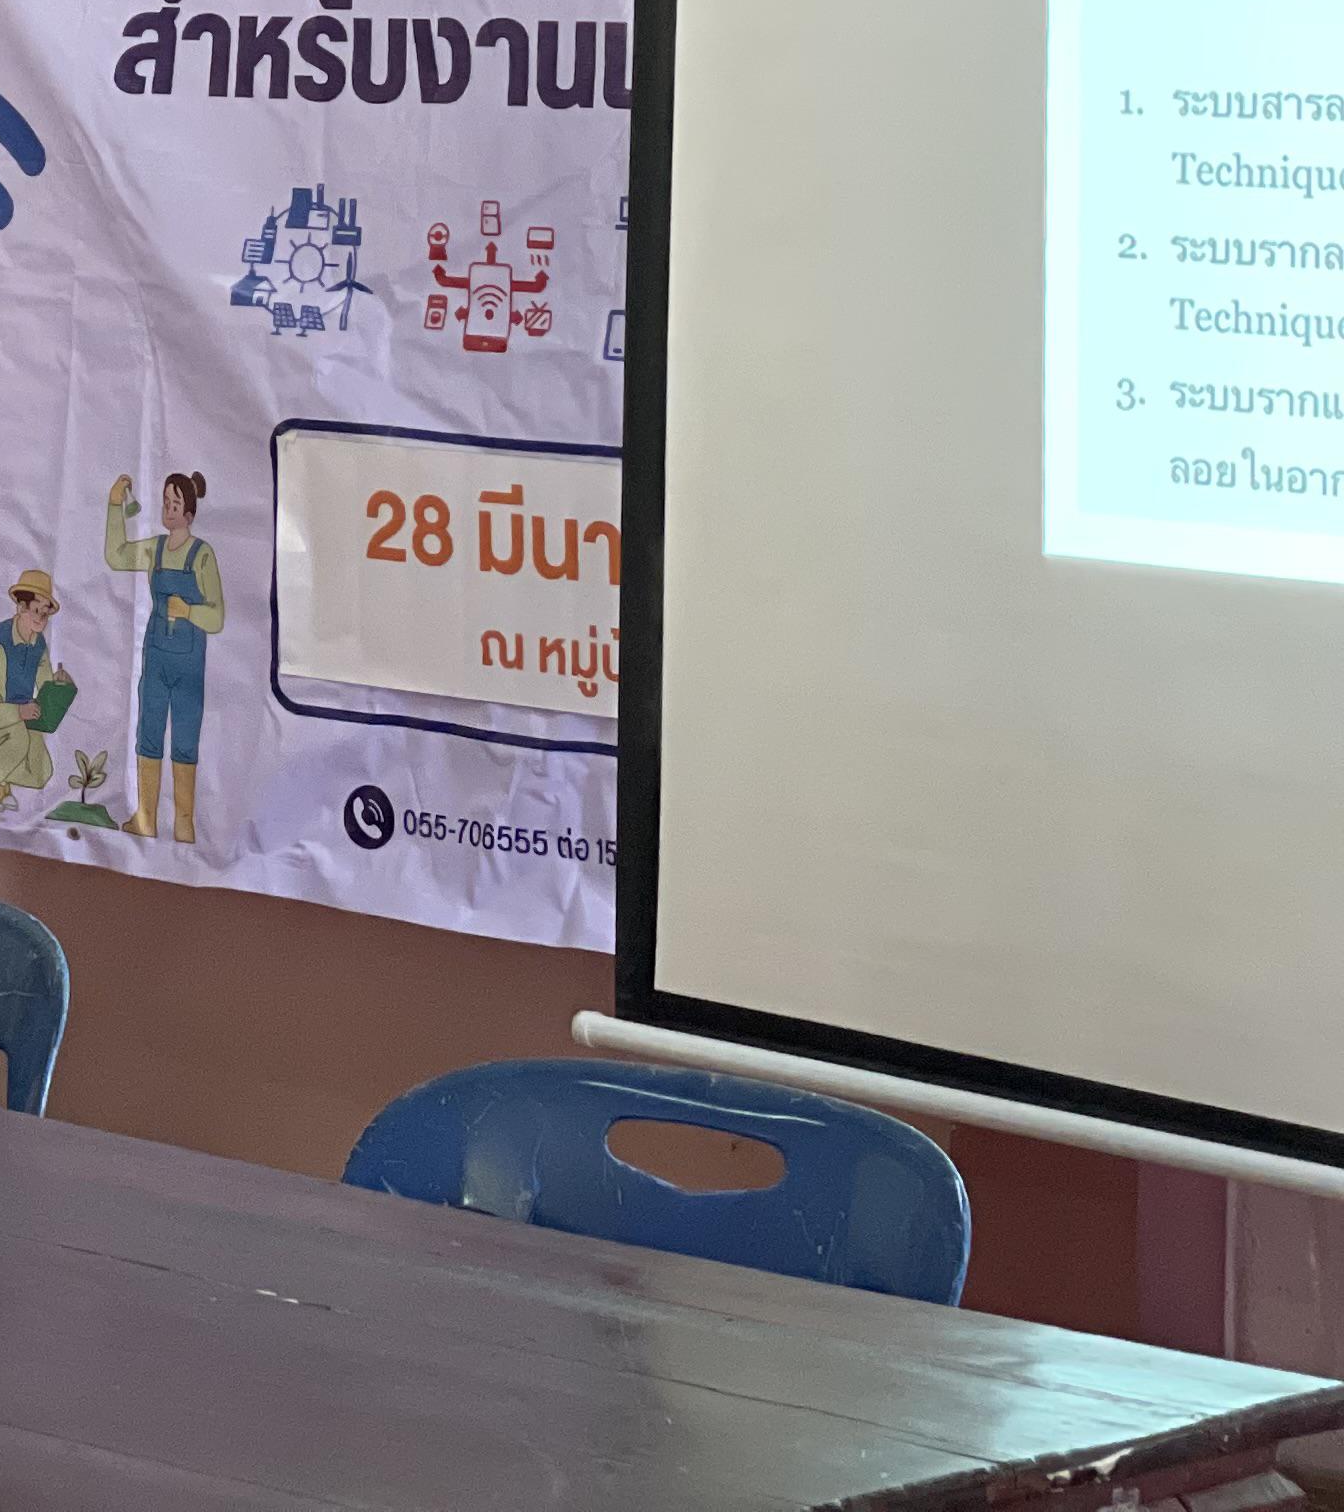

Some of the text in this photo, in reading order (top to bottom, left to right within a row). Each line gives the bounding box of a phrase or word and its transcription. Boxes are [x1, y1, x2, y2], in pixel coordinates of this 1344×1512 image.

[1119, 89, 1144, 116] 1.
[1172, 152, 1344, 199] Techniqu
[1117, 233, 1344, 271] 2. ระบบรากล
[1115, 378, 1146, 412] 3.
[366, 483, 621, 587] 28 มีนา
[480, 629, 524, 671] ณ
[403, 809, 549, 857] 055-706555
[557, 827, 590, 862] ต่อ
